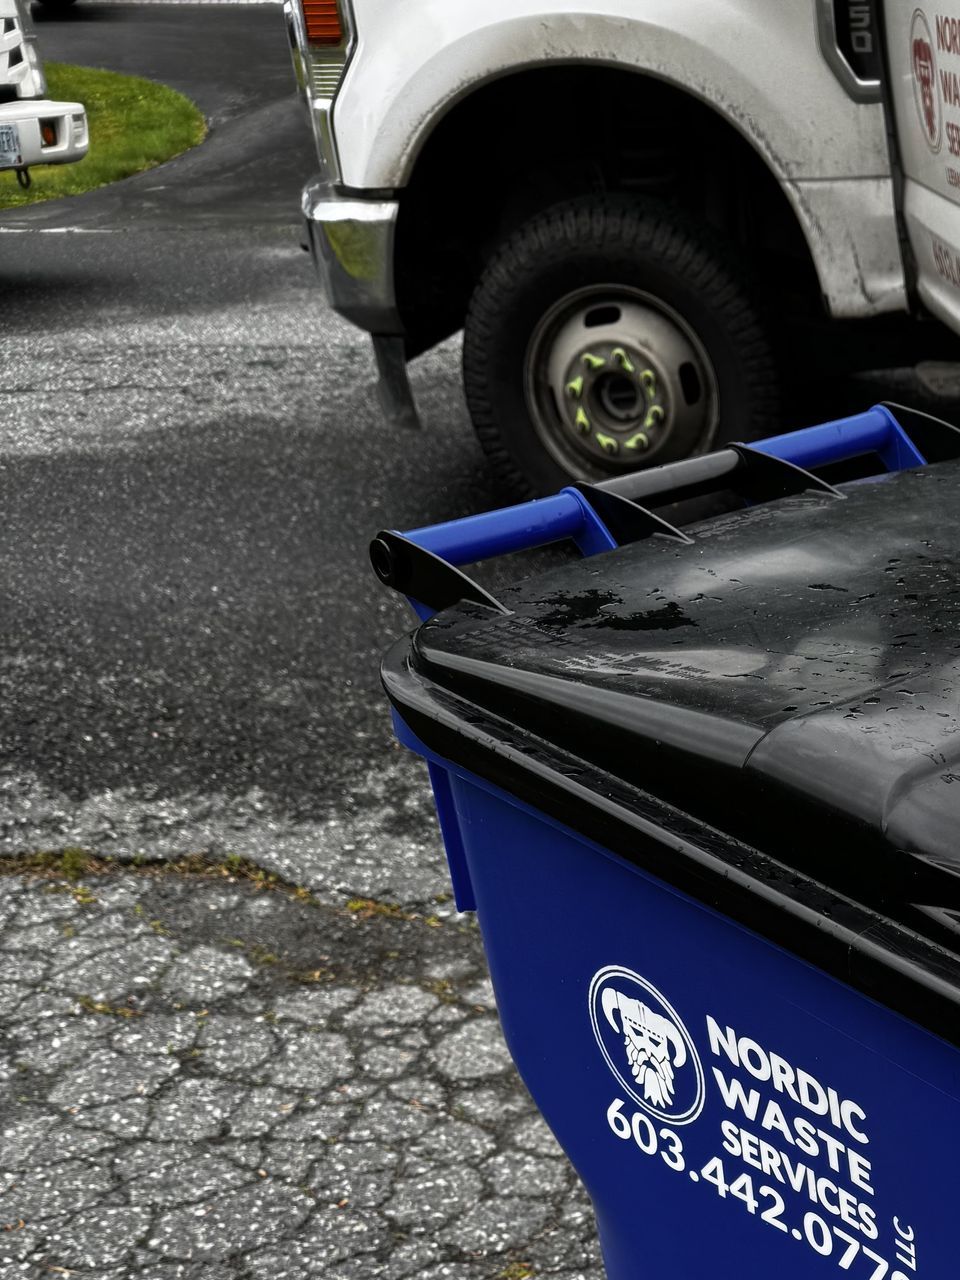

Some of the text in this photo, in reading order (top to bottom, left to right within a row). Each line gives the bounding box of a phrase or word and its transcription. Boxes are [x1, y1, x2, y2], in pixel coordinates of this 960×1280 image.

[705, 1014, 870, 1144] NORDIC
[711, 1066, 875, 1196] WASTE
[720, 1120, 879, 1240] SERVICES
[893, 1215, 917, 1271] LLC
